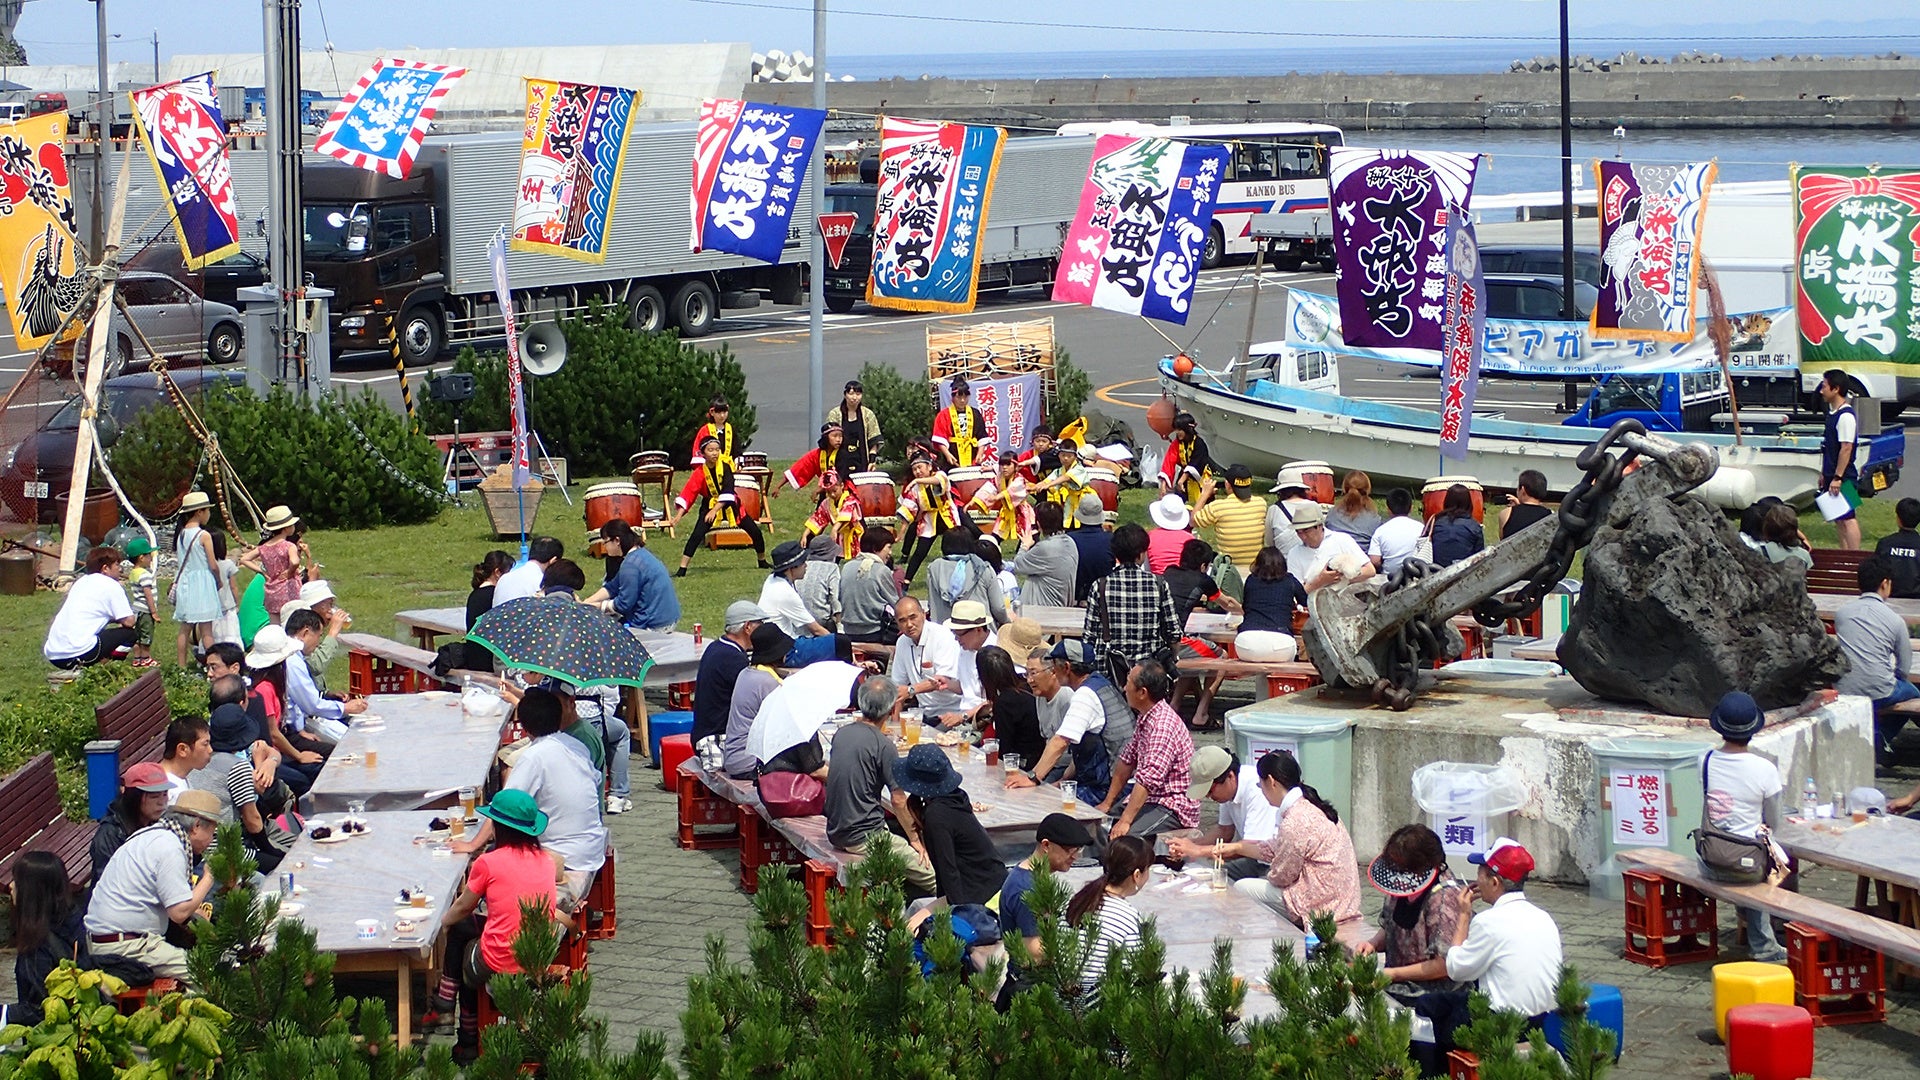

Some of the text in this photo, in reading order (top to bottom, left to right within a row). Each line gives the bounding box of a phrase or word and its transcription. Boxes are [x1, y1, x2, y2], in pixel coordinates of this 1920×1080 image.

[1246, 183, 1296, 197] KANKO BUS
[826, 224, 848, 237] 止まれ
[1008, 383, 1024, 448] 利尻富士町
[1890, 547, 1916, 557] NFTB
[1617, 774, 1635, 834] ゴミ
[1637, 774, 1659, 834] 燃やせる
